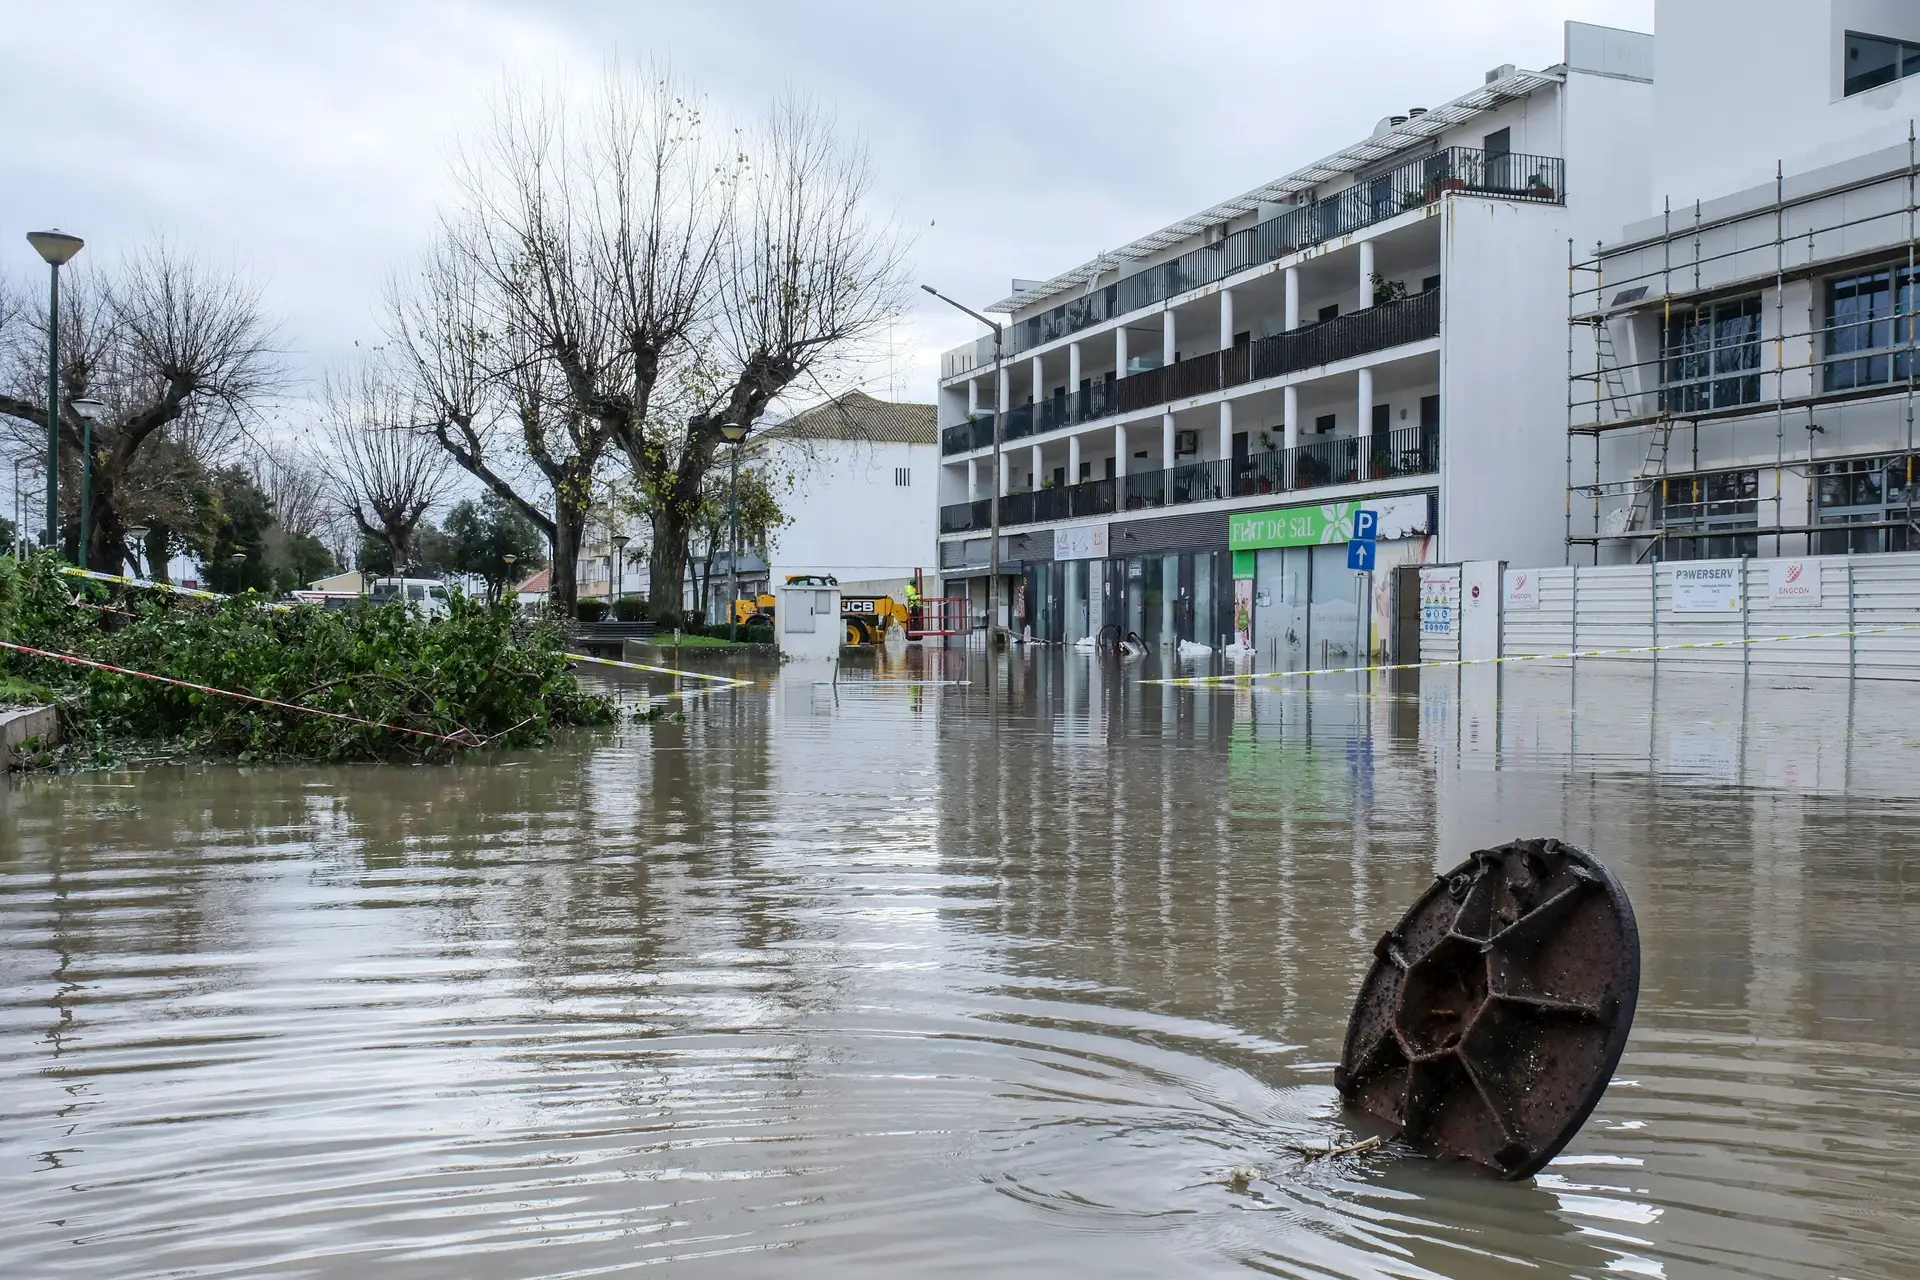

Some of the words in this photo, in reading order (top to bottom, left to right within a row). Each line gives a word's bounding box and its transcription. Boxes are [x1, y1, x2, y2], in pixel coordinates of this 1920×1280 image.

[1358, 513, 1373, 537] P
[1676, 568, 1734, 580] POWERSERV
[1778, 587, 1810, 595] ENGCON
[841, 601, 874, 612] JCB
